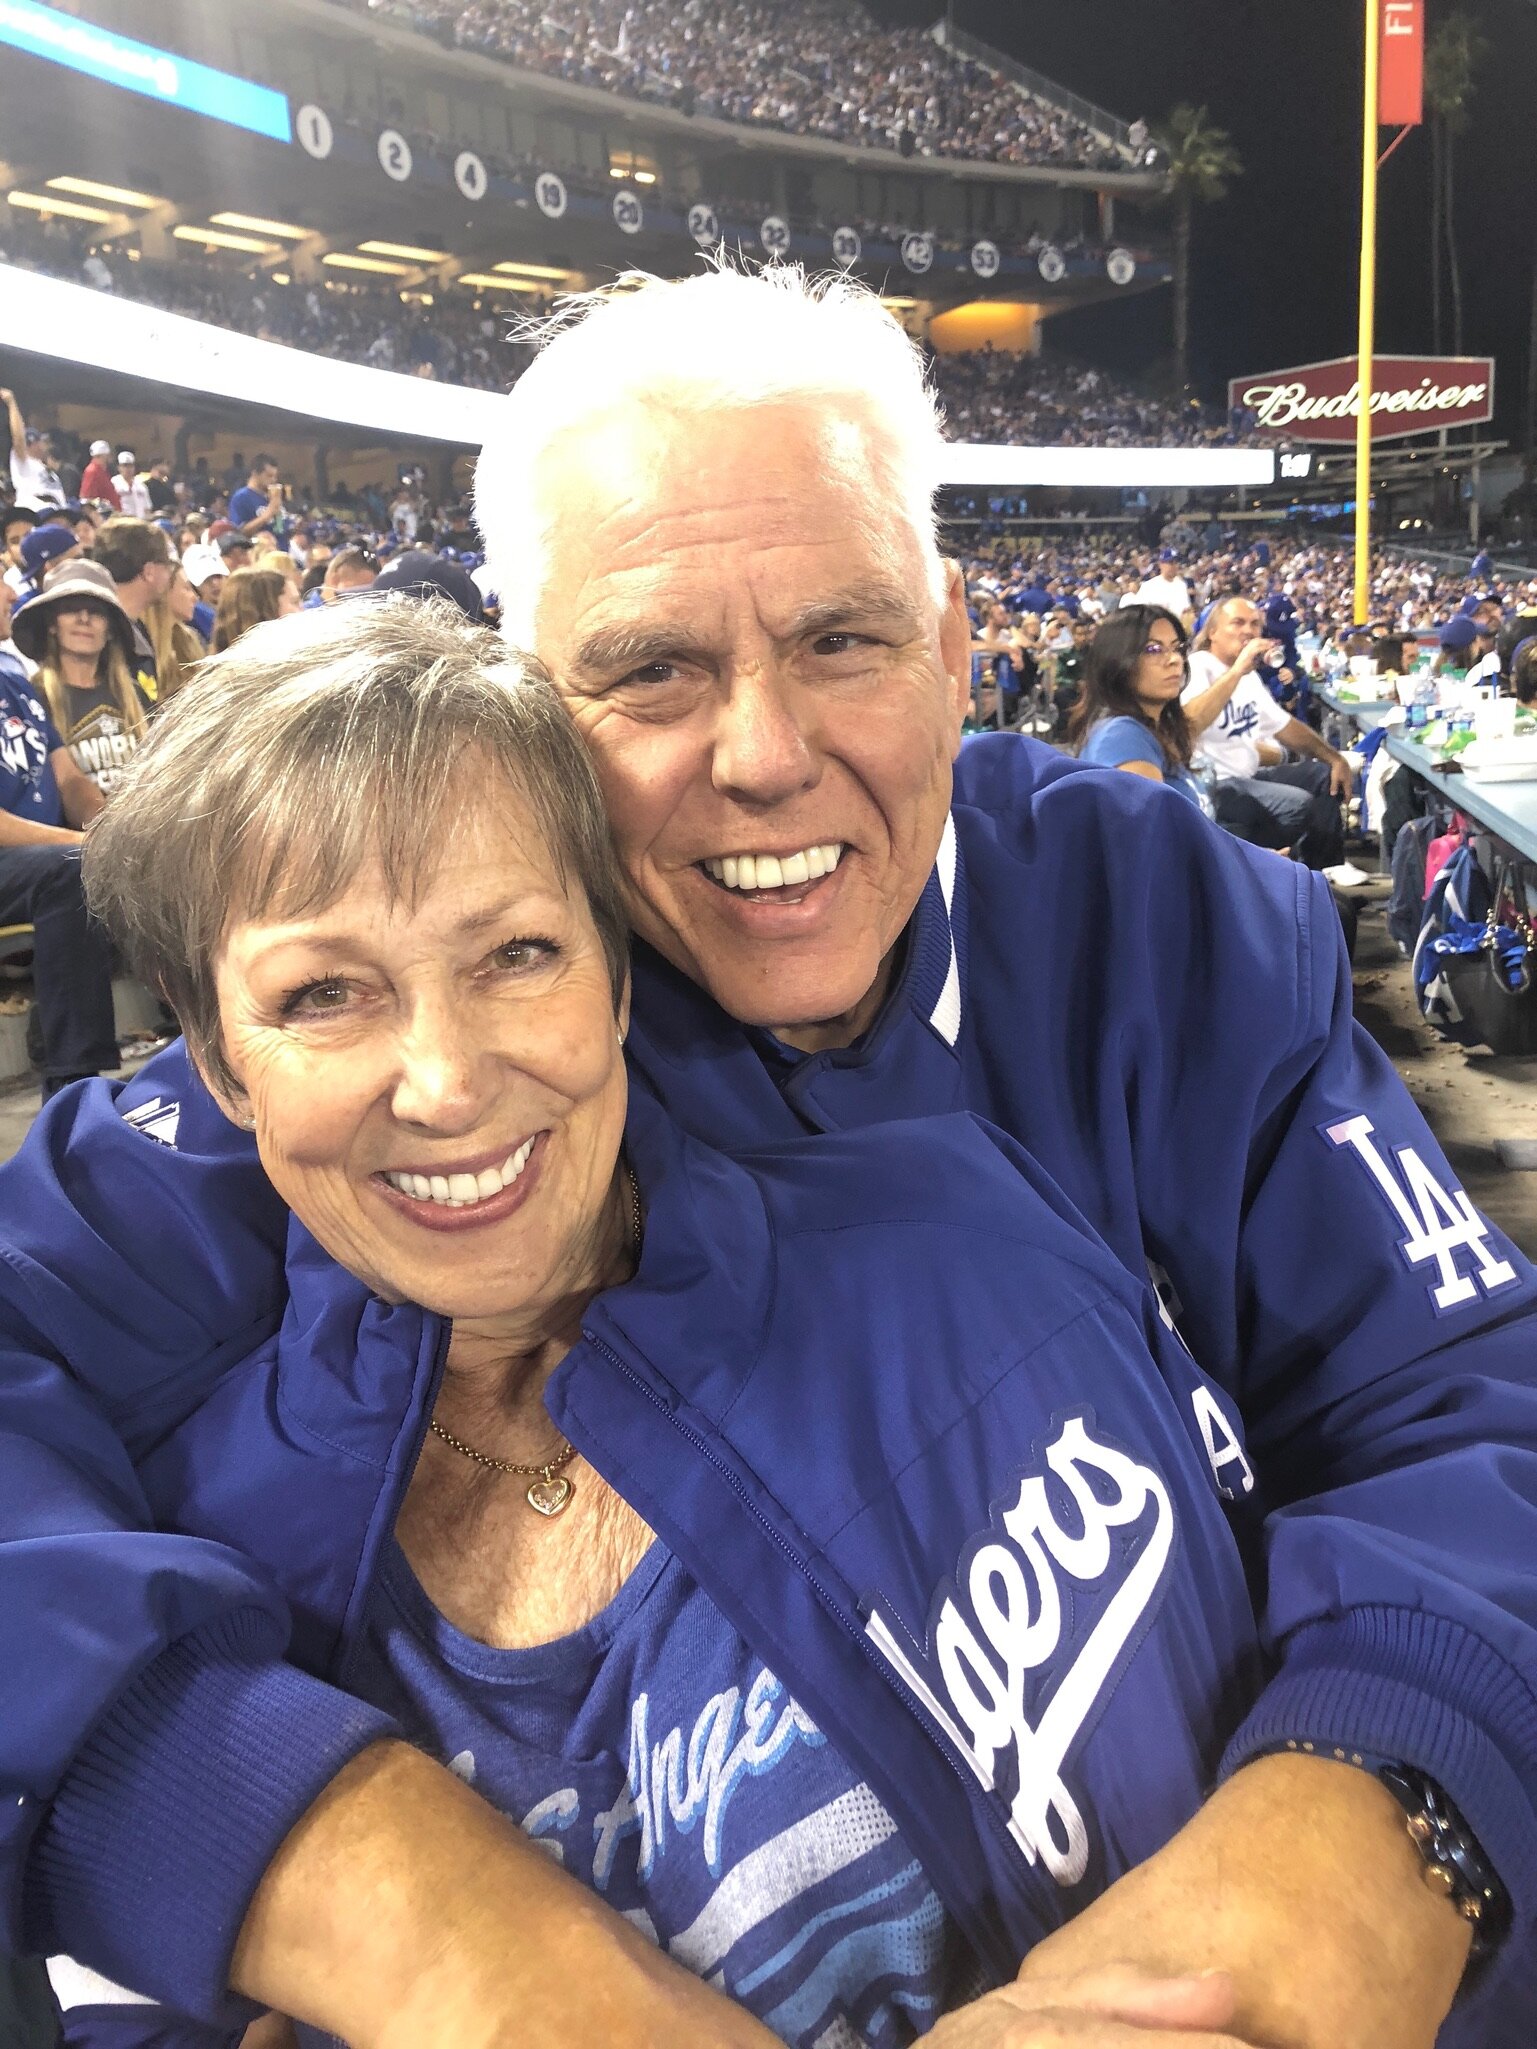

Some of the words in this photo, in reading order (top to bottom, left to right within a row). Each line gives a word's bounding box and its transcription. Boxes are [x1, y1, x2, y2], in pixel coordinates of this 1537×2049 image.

[389, 141, 403, 170] 2
[463, 163, 477, 189] 4
[1242, 377, 1487, 428] Budweiser
[1326, 1114, 1517, 1309] LA
